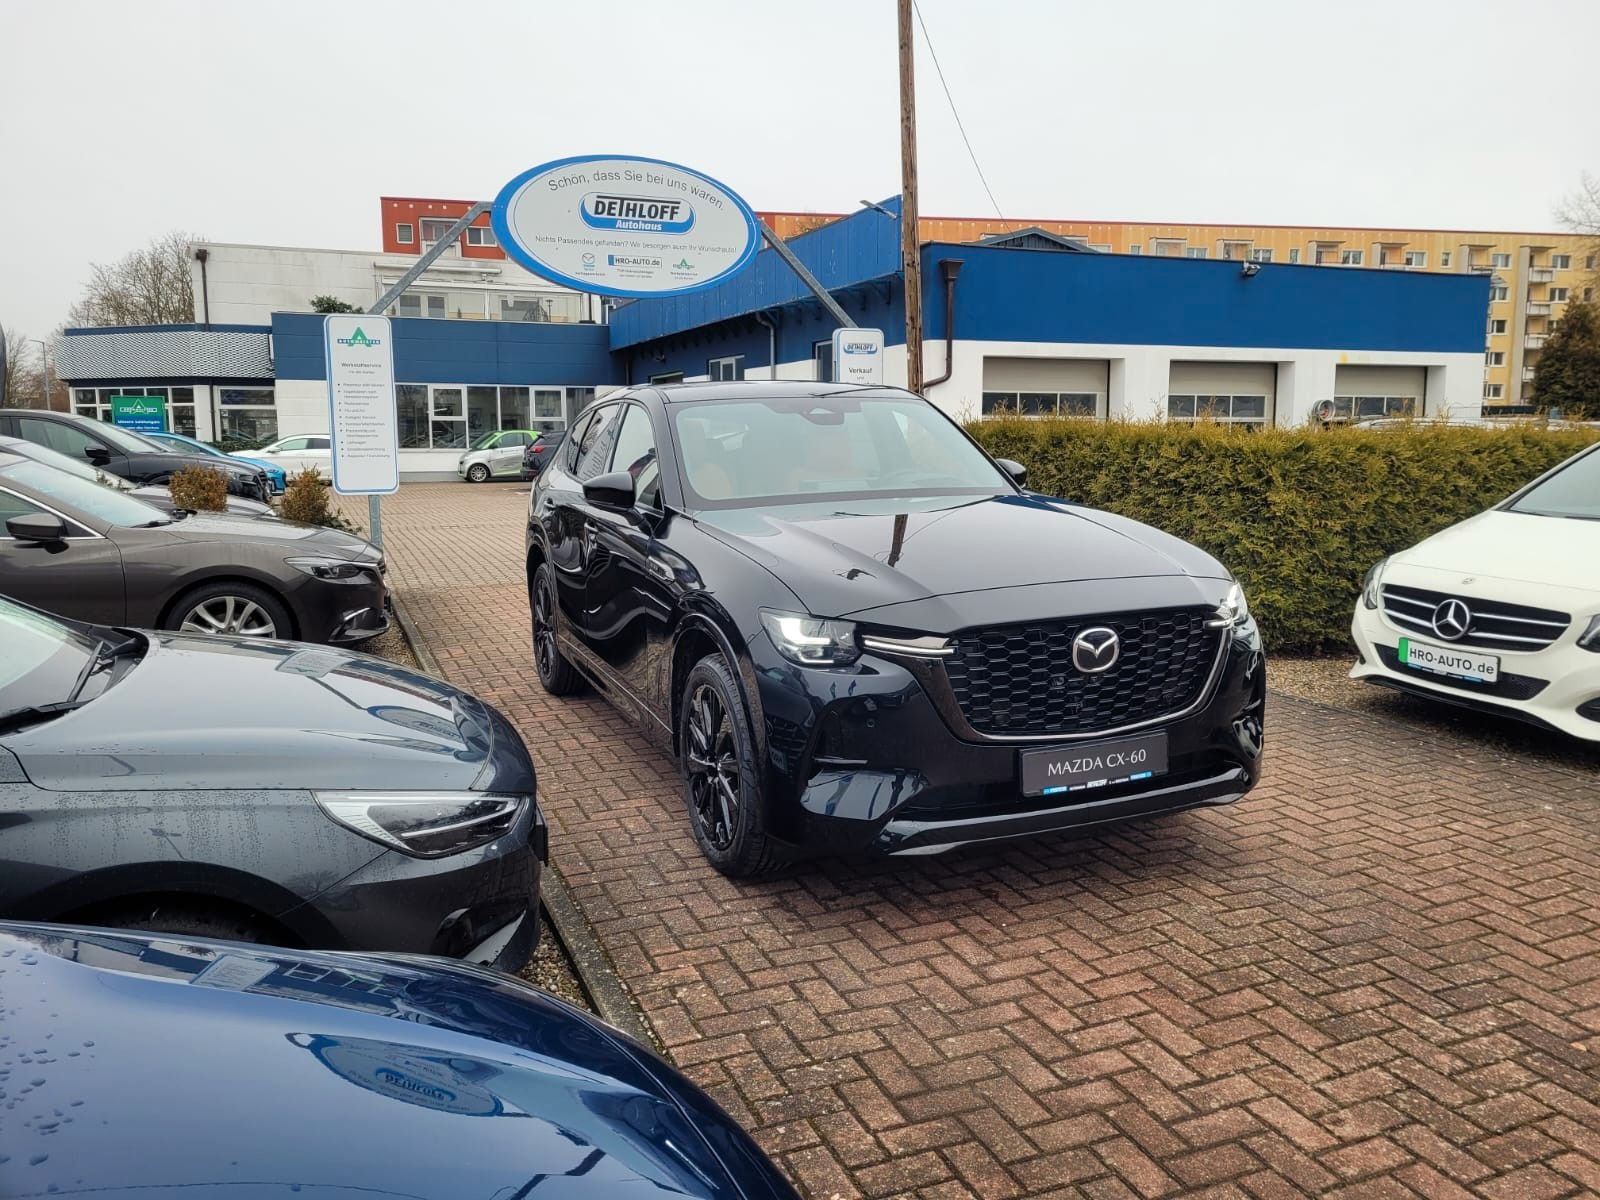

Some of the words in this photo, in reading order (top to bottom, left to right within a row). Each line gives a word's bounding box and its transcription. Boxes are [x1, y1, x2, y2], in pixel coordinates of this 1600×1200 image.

[548, 173, 590, 191] Schön,
[593, 170, 621, 181] dass
[624, 170, 642, 181] Sie
[646, 172, 664, 185] bei
[667, 178, 687, 191] uns
[690, 185, 723, 211] waren.
[594, 195, 681, 220] DETHLOFF
[616, 220, 662, 231] Autohaus
[535, 235, 556, 243] Nichts
[557, 236, 593, 246] Passendes
[594, 239, 629, 248] gefunden?
[642, 241, 671, 251] besorgen
[615, 257, 660, 266] HRO-AUTO.de
[1409, 647, 1494, 674] HRO-AUTO.de
[1047, 756, 1103, 776] MAZDA
[1106, 749, 1147, 768] CX-60
